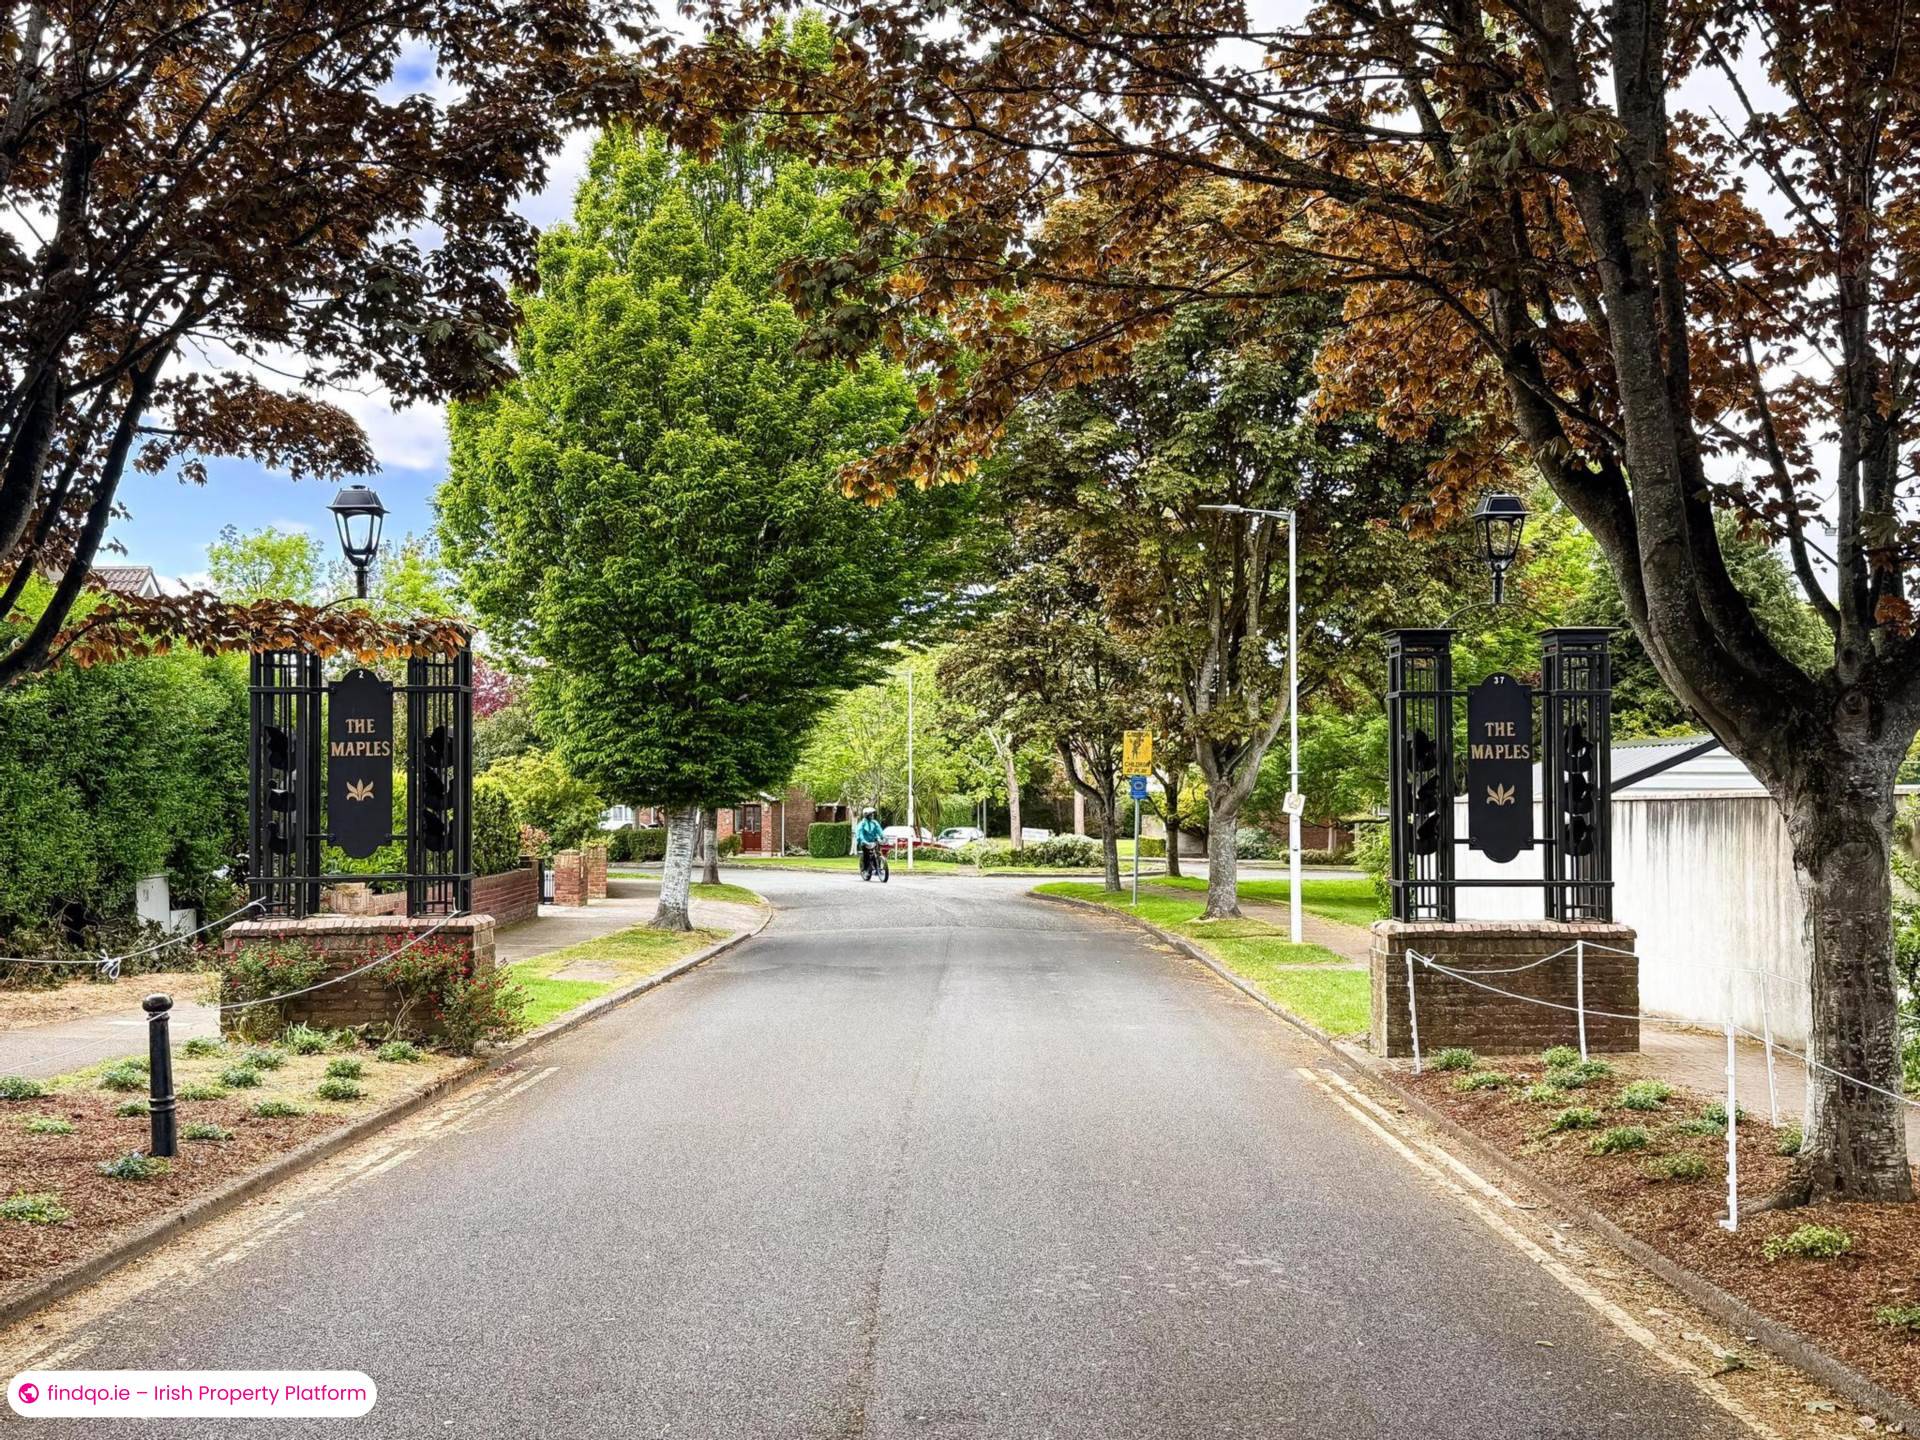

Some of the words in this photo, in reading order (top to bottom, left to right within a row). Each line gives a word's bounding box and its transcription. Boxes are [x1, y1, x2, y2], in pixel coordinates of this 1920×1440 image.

[358, 670, 364, 679] 2
[1493, 676, 1505, 685] 37
[345, 718, 376, 734] THE
[1485, 721, 1516, 737] THE
[330, 741, 391, 757] MAPLES
[1471, 744, 1530, 760] MAPLES
